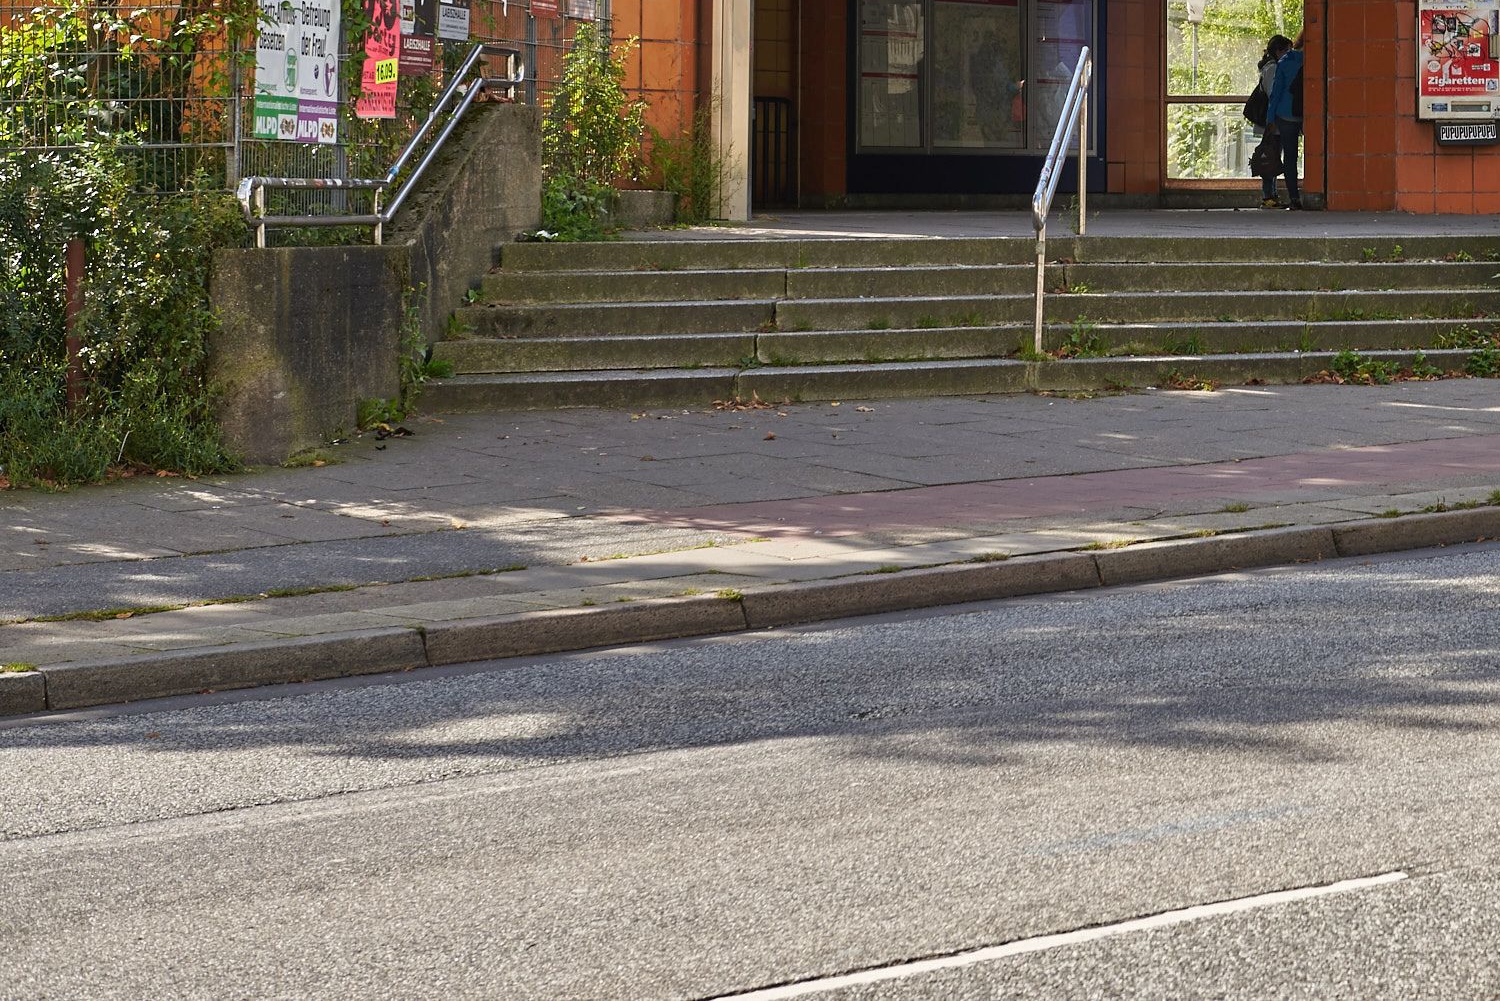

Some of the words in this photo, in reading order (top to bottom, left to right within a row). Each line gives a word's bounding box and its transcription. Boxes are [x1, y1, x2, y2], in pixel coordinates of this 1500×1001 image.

[1427, 76, 1485, 87] Zigaretten
[255, 116, 277, 135] MLPD
[298, 120, 318, 138] MLPD
